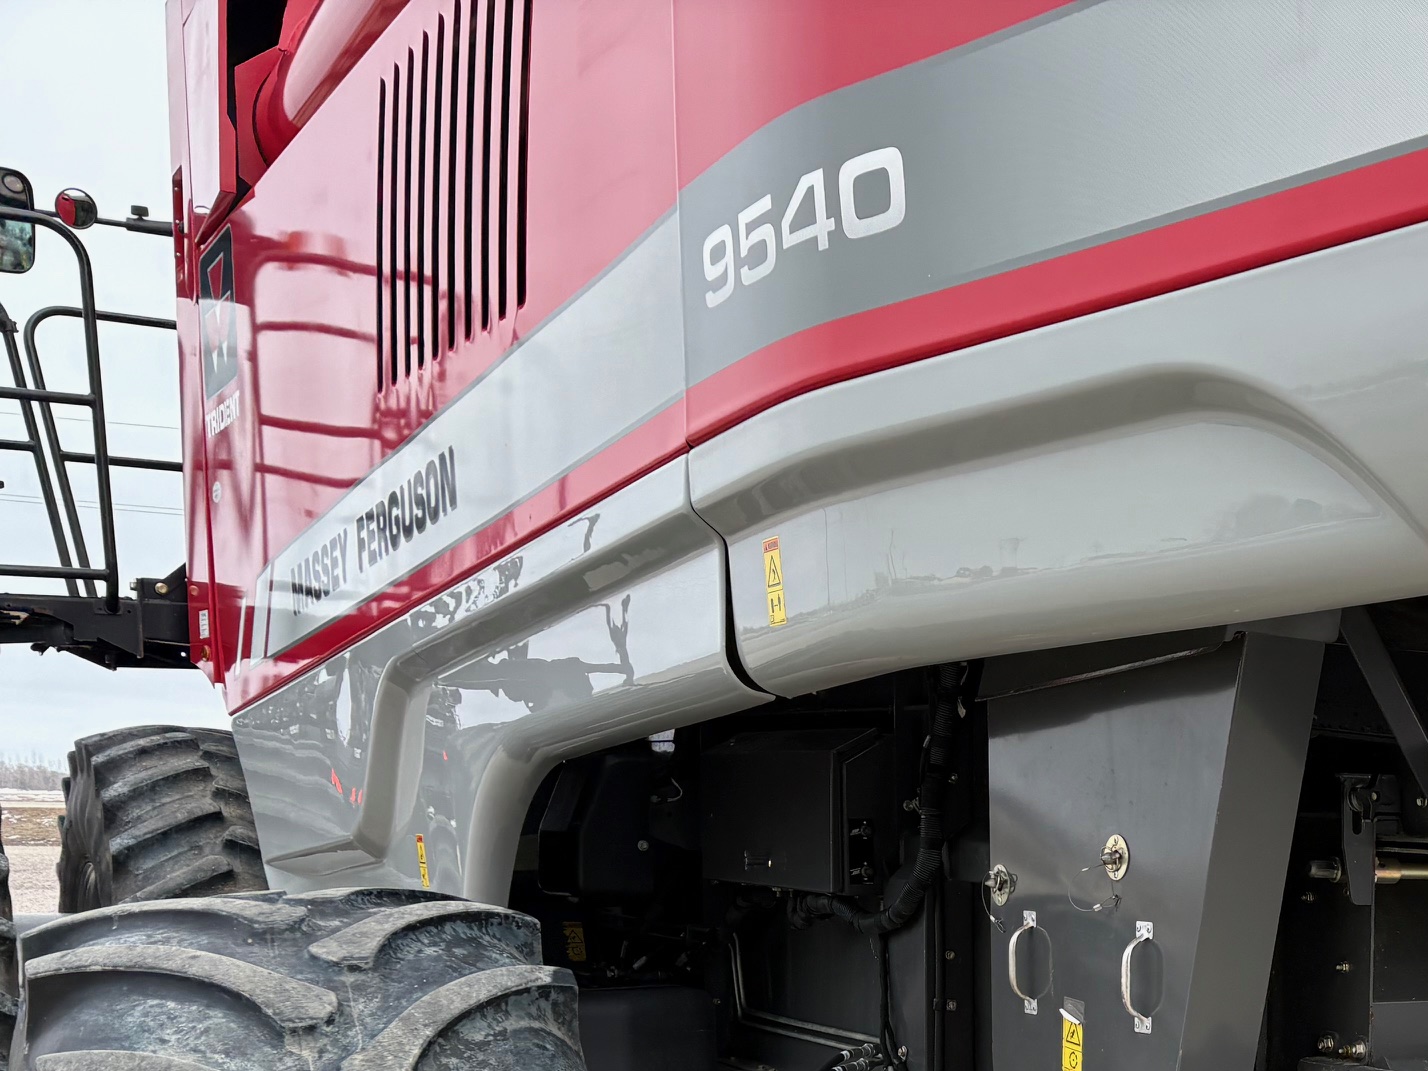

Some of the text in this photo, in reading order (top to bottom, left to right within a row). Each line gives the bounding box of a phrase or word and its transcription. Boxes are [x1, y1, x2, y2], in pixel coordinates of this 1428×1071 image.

[703, 146, 906, 308] 9540
[206, 389, 240, 438] TRIDENT
[290, 445, 458, 616] MASSEY FERGUSON
